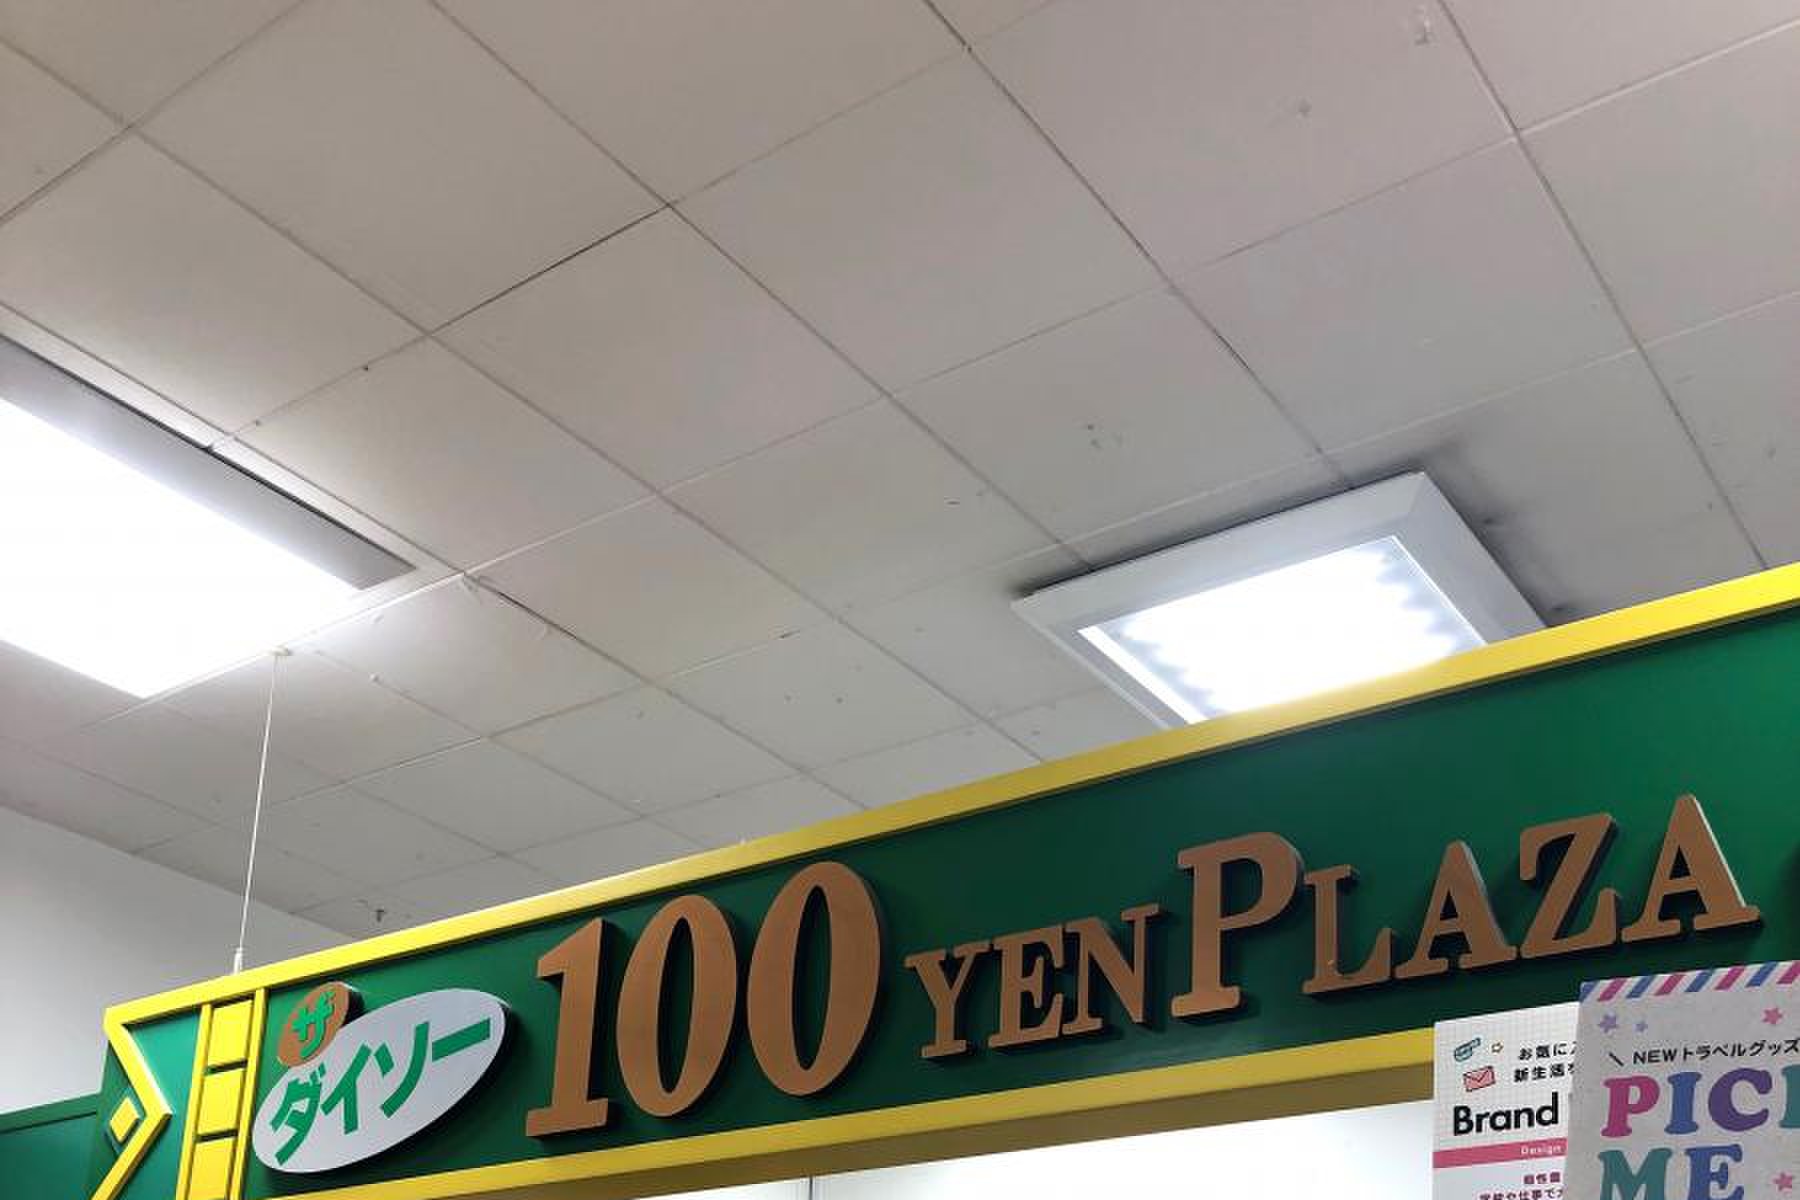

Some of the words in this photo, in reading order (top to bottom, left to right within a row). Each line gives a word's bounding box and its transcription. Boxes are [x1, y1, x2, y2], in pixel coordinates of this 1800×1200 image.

[526, 861, 881, 1139] 100
[902, 904, 1161, 1062] YEN
[1171, 794, 1761, 1020] PLAZA
[293, 992, 335, 1060] ザ
[268, 1018, 492, 1167] ダイソー
[1453, 1091, 1559, 1137] Brand
